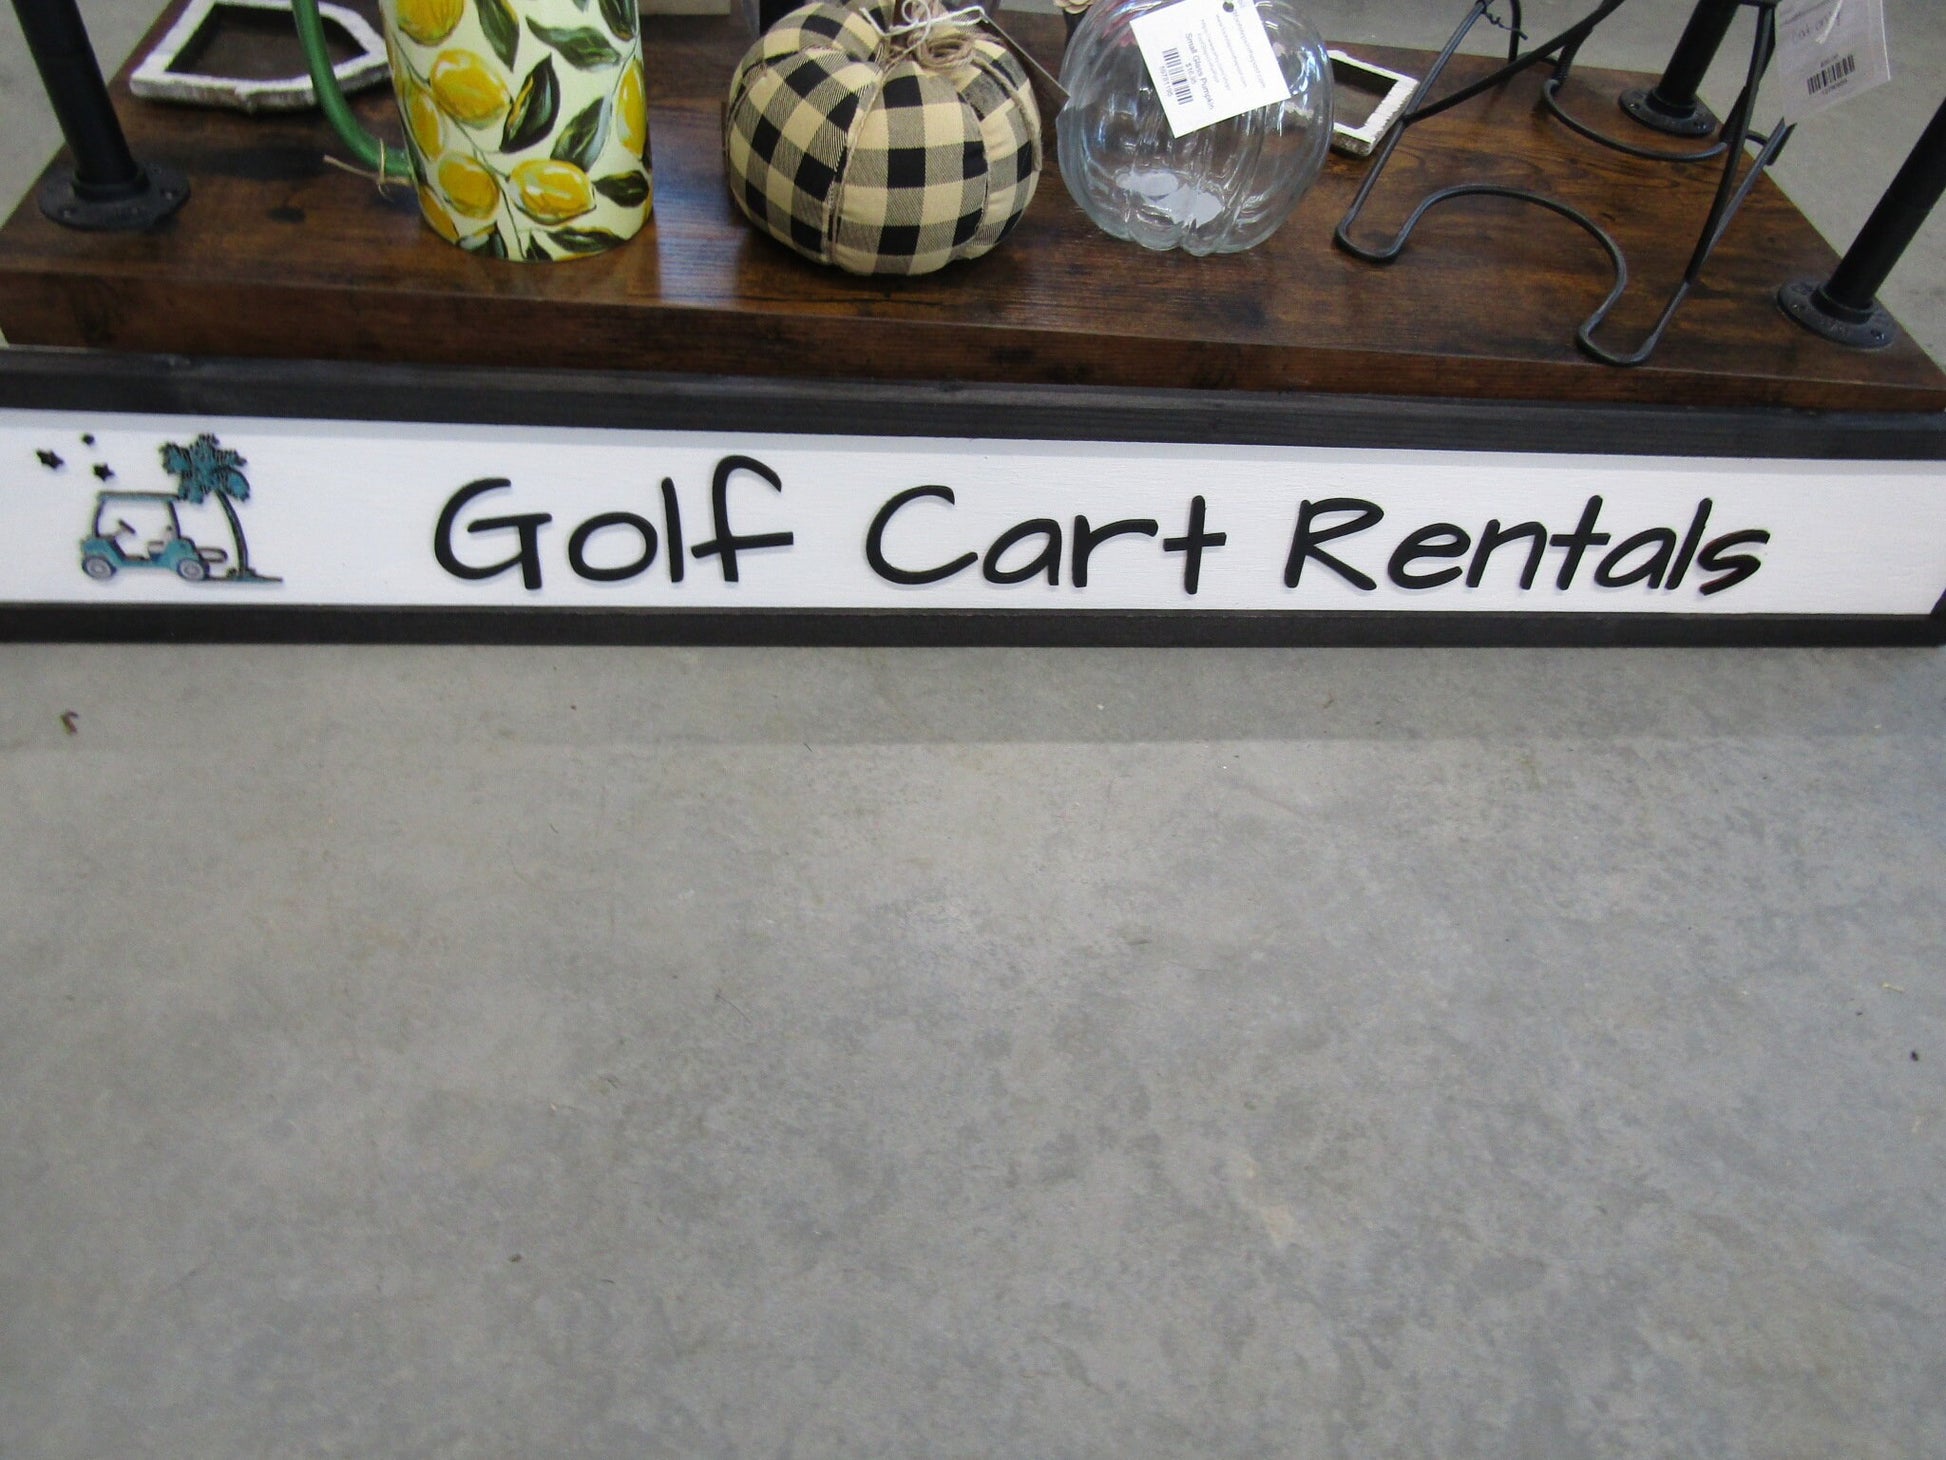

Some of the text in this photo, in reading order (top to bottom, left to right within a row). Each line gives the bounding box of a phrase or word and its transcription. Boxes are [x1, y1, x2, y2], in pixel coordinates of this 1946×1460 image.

[1185, 33, 1198, 54] Small
[1192, 54, 1204, 77] Glass
[1200, 77, 1214, 110] Pumpkin
[434, 455, 1771, 597] Golf Cart Rentals
